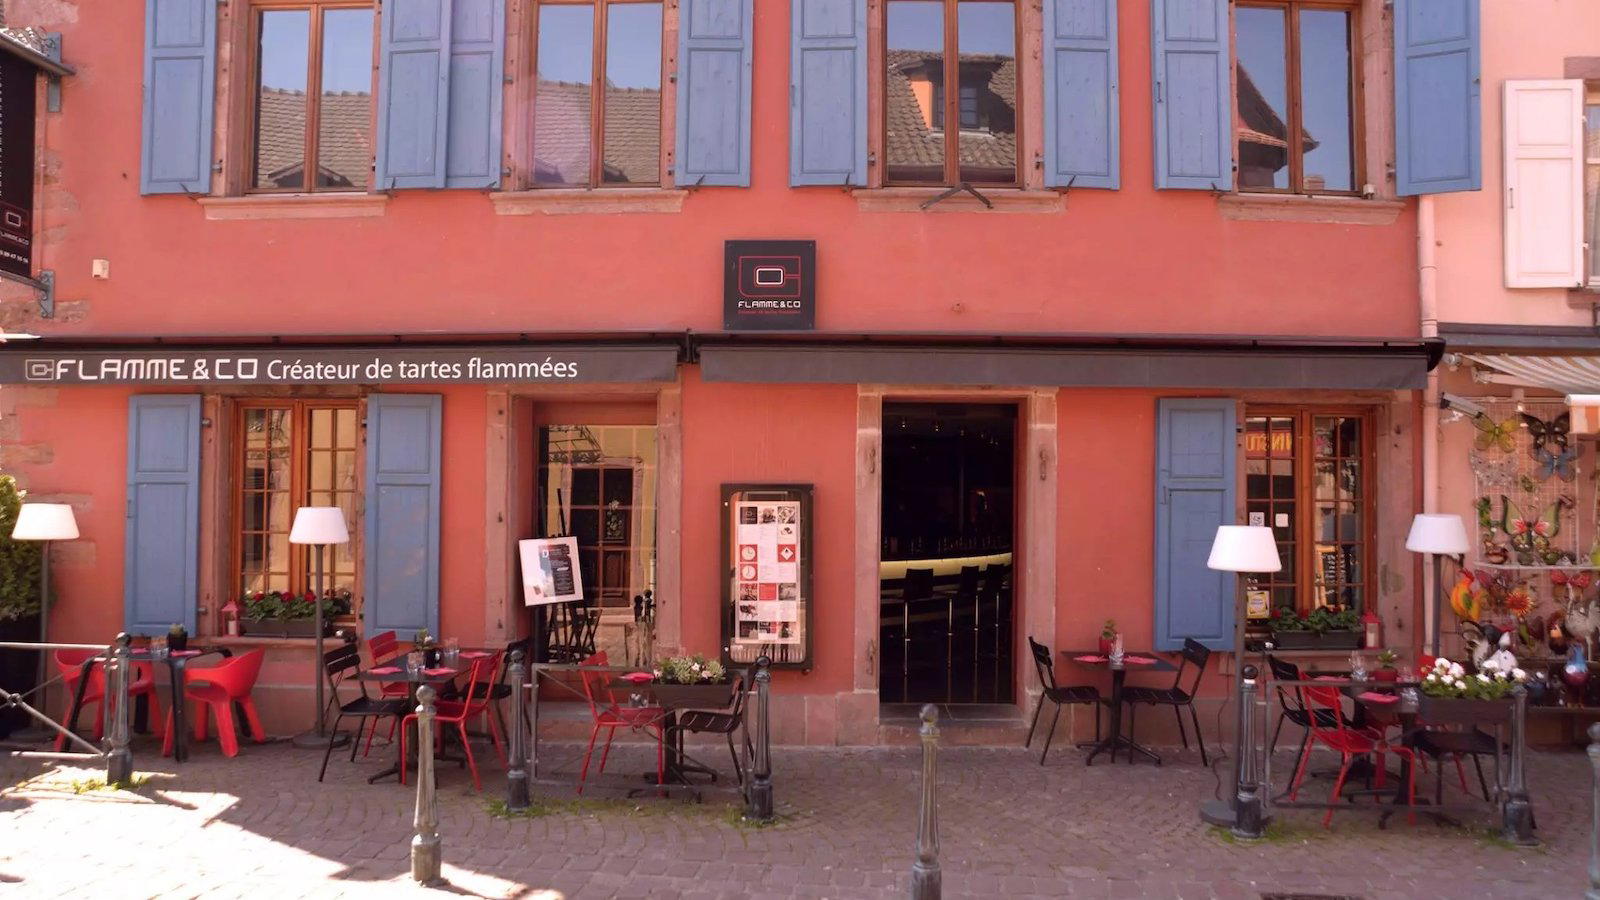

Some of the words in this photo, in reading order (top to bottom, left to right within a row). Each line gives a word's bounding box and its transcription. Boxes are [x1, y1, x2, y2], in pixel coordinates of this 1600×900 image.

[737, 300, 801, 309] FLAMME&CO
[55, 358, 259, 381] FLAMME&CO
[266, 359, 360, 380] Créateur
[365, 358, 393, 379] de
[399, 360, 462, 379] tartes
[467, 356, 578, 379] flammées
